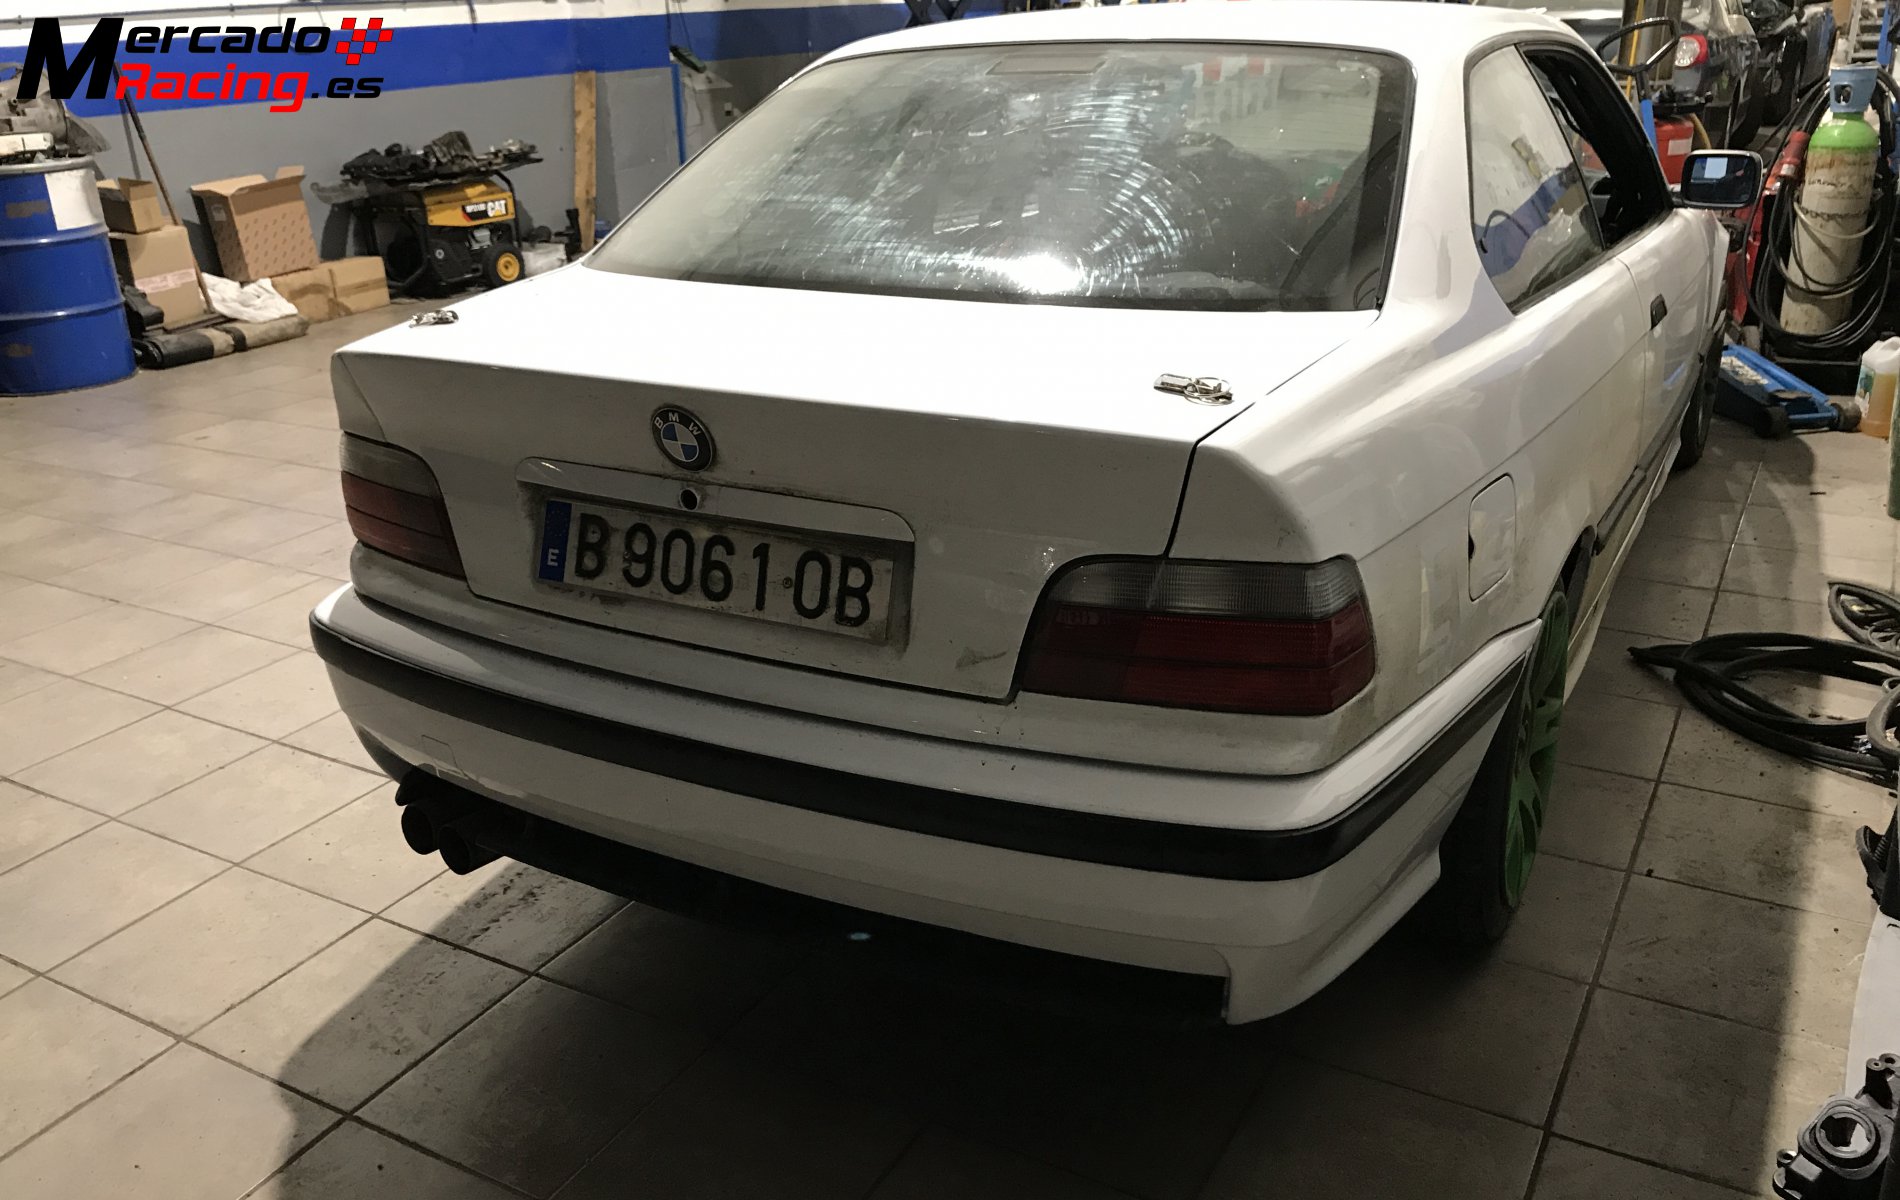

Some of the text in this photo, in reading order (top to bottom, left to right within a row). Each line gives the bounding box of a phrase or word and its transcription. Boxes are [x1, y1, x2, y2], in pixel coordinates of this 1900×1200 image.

[487, 199, 506, 217] CAT
[654, 411, 701, 436] BMW
[546, 548, 559, 567] E
